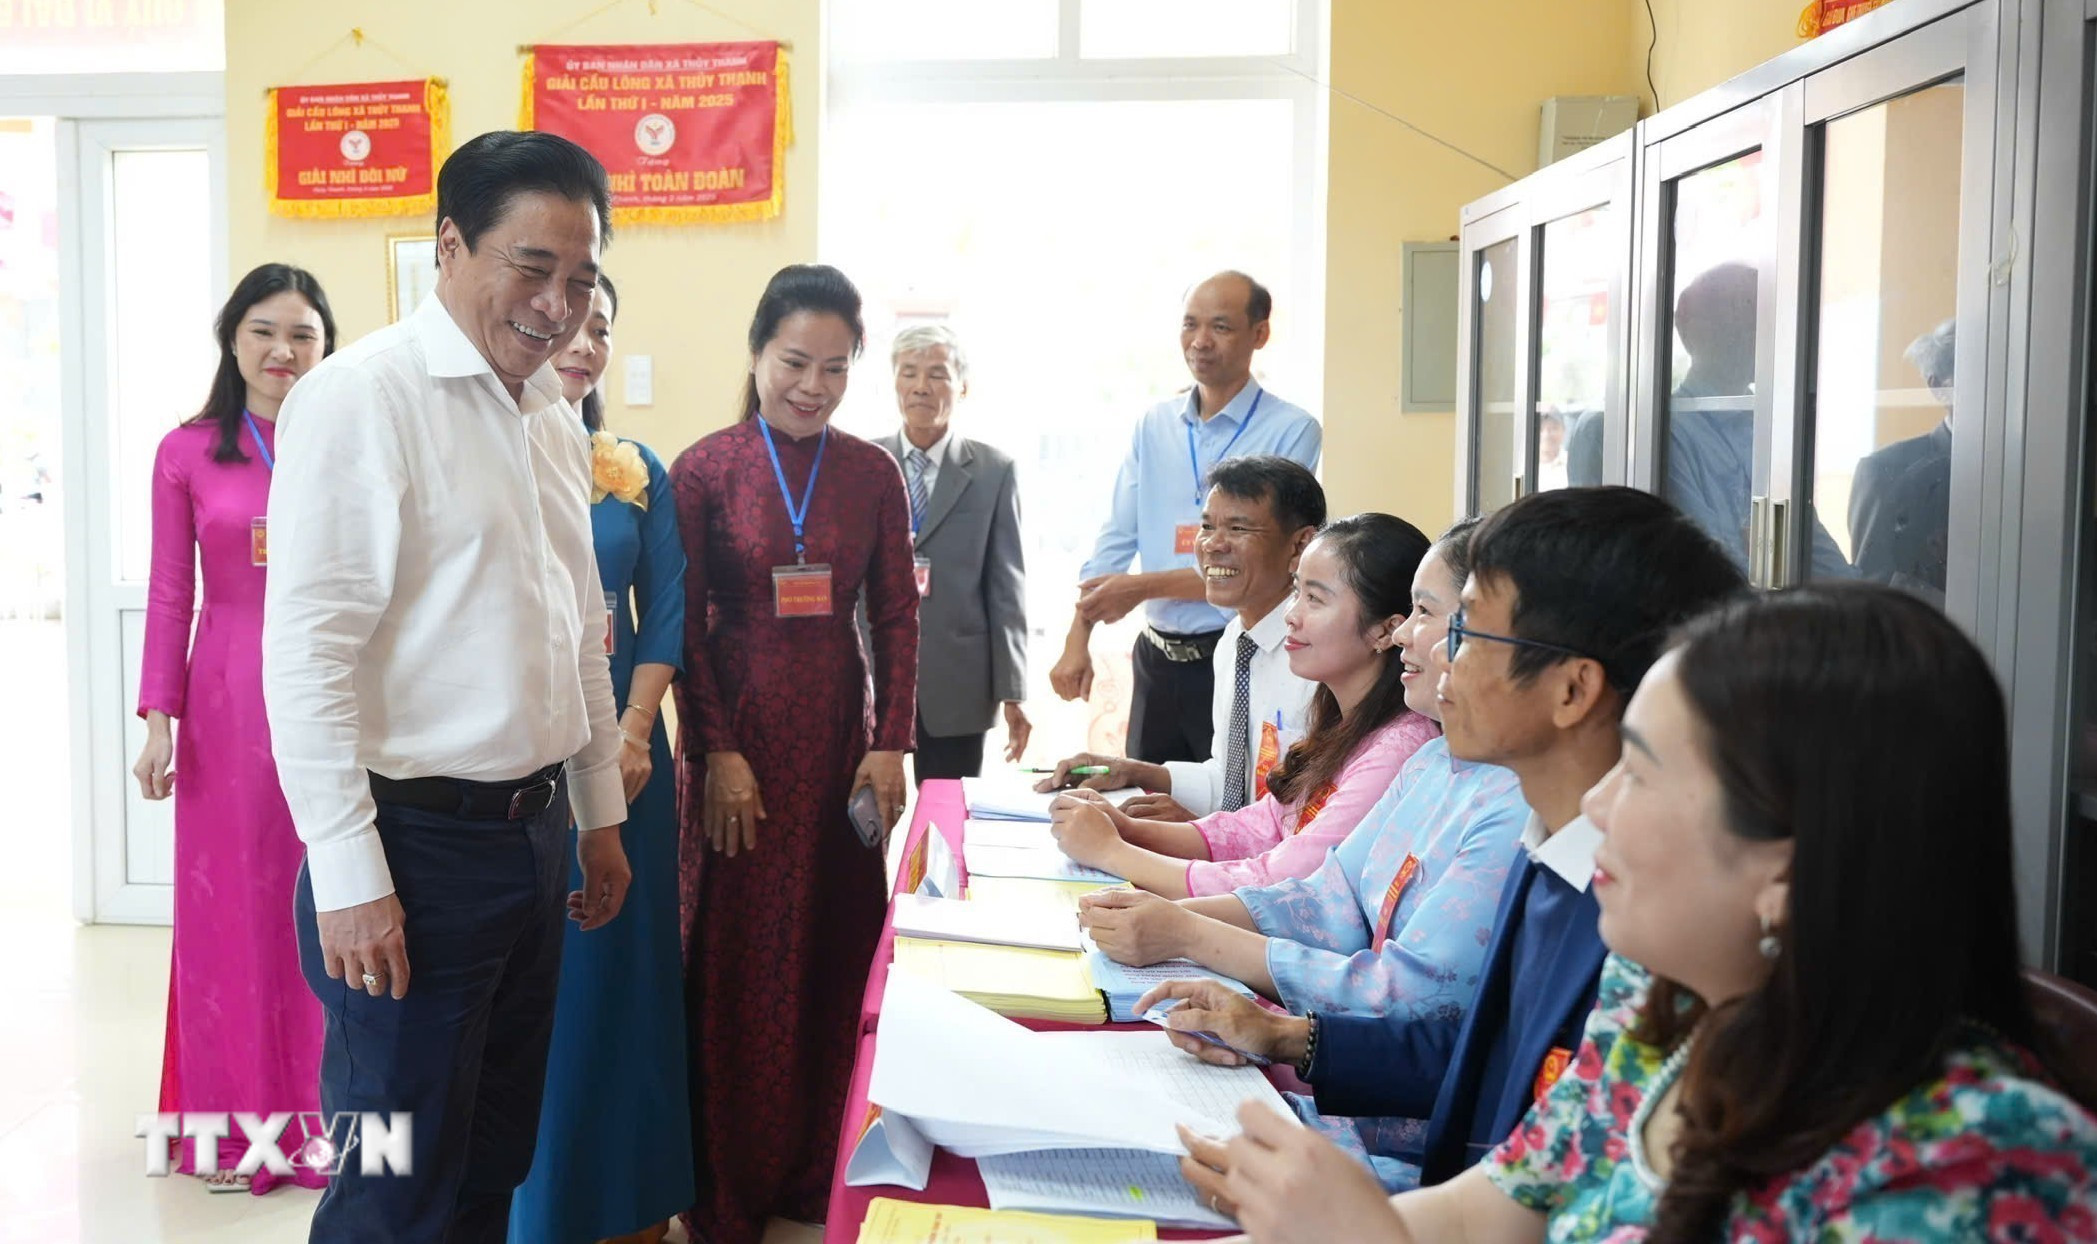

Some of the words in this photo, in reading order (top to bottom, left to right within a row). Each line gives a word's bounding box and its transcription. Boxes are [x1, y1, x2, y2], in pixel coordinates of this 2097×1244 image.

[546, 73, 577, 90] GIẢI
[580, 73, 609, 90] CẦU
[612, 74, 651, 90] LÔNG
[655, 74, 675, 89] XÃ
[717, 71, 767, 87] THANH
[577, 94, 606, 110] LẦN
[660, 94, 695, 110] NĂM
[298, 167, 327, 186] GIẢI
[640, 168, 689, 193] TOÀN
[692, 166, 745, 191] ĐOÀN
